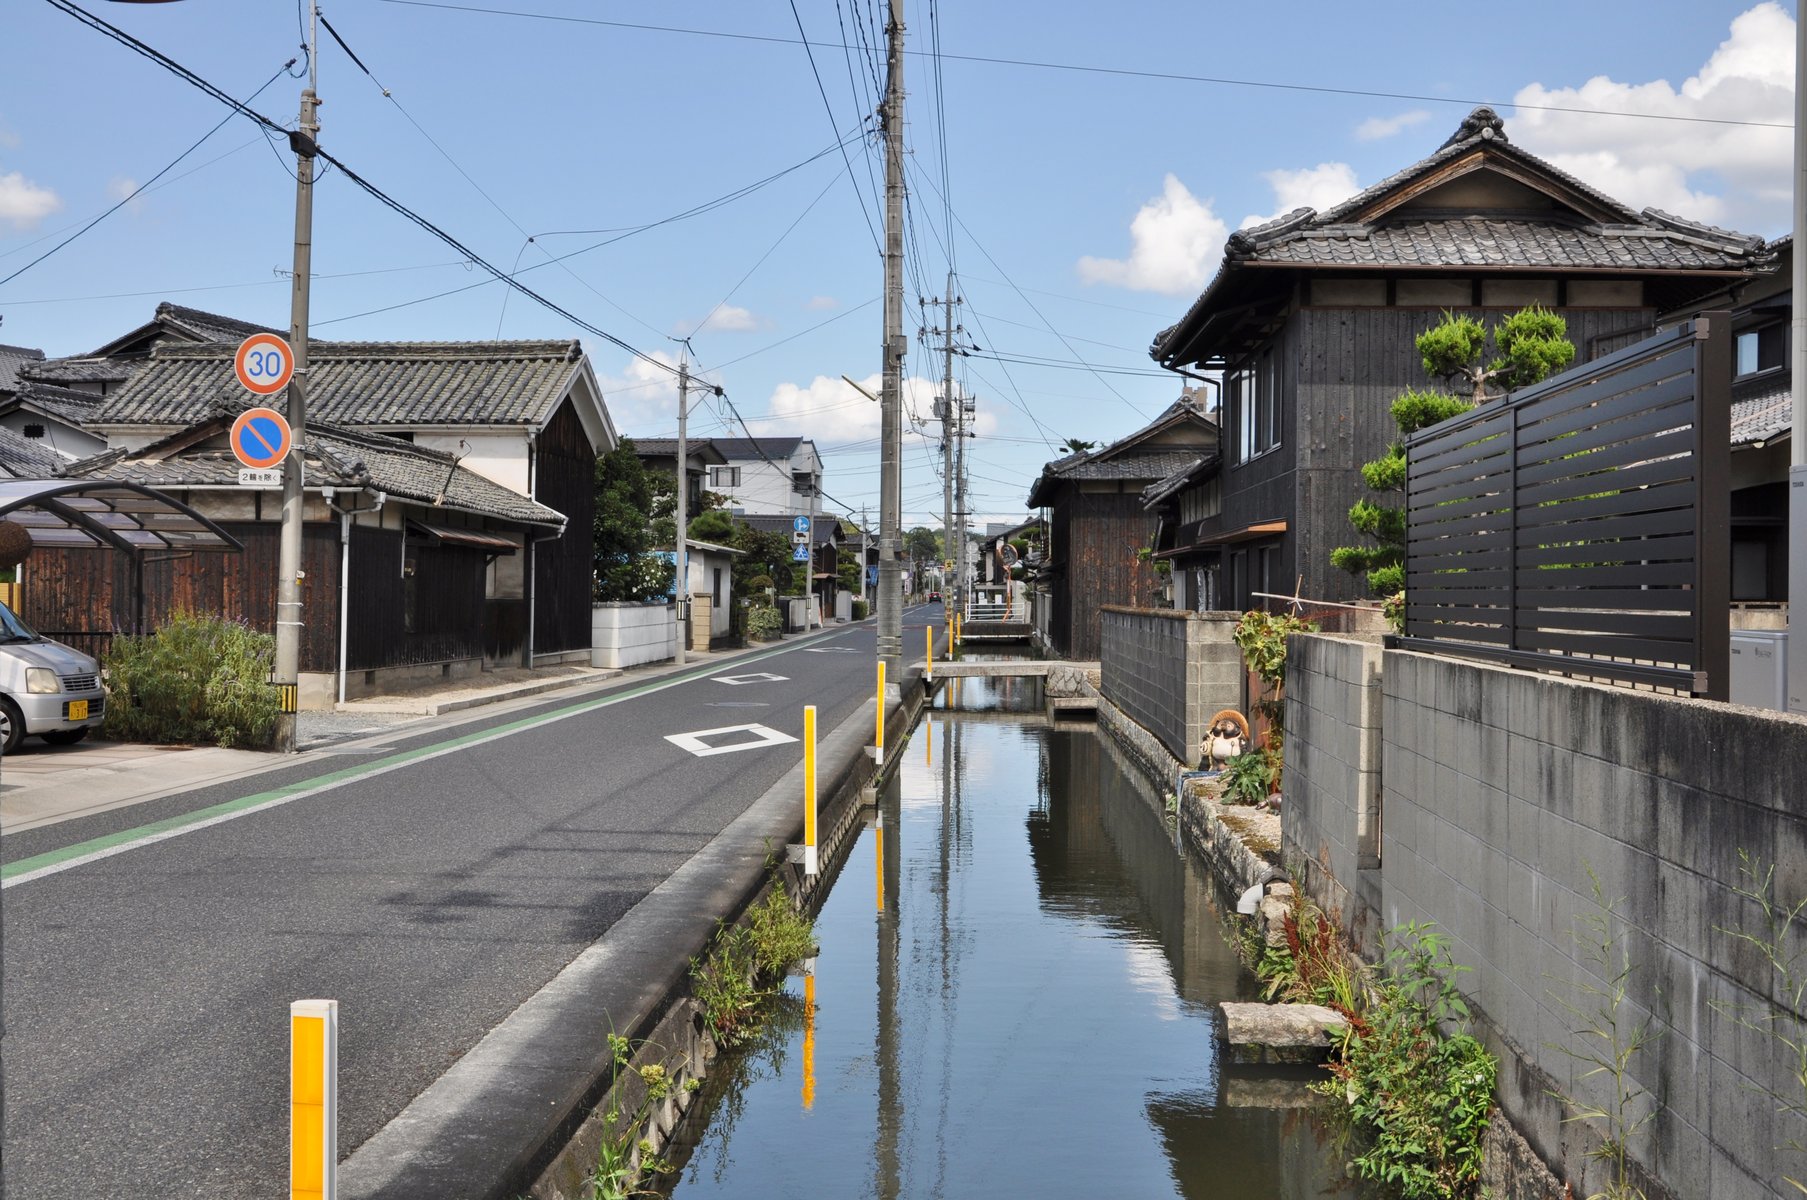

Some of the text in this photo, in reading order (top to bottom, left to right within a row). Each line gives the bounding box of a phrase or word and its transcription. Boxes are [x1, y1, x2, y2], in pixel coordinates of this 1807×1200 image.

[249, 351, 280, 377] 30
[242, 473, 277, 481] 2輪を除く
